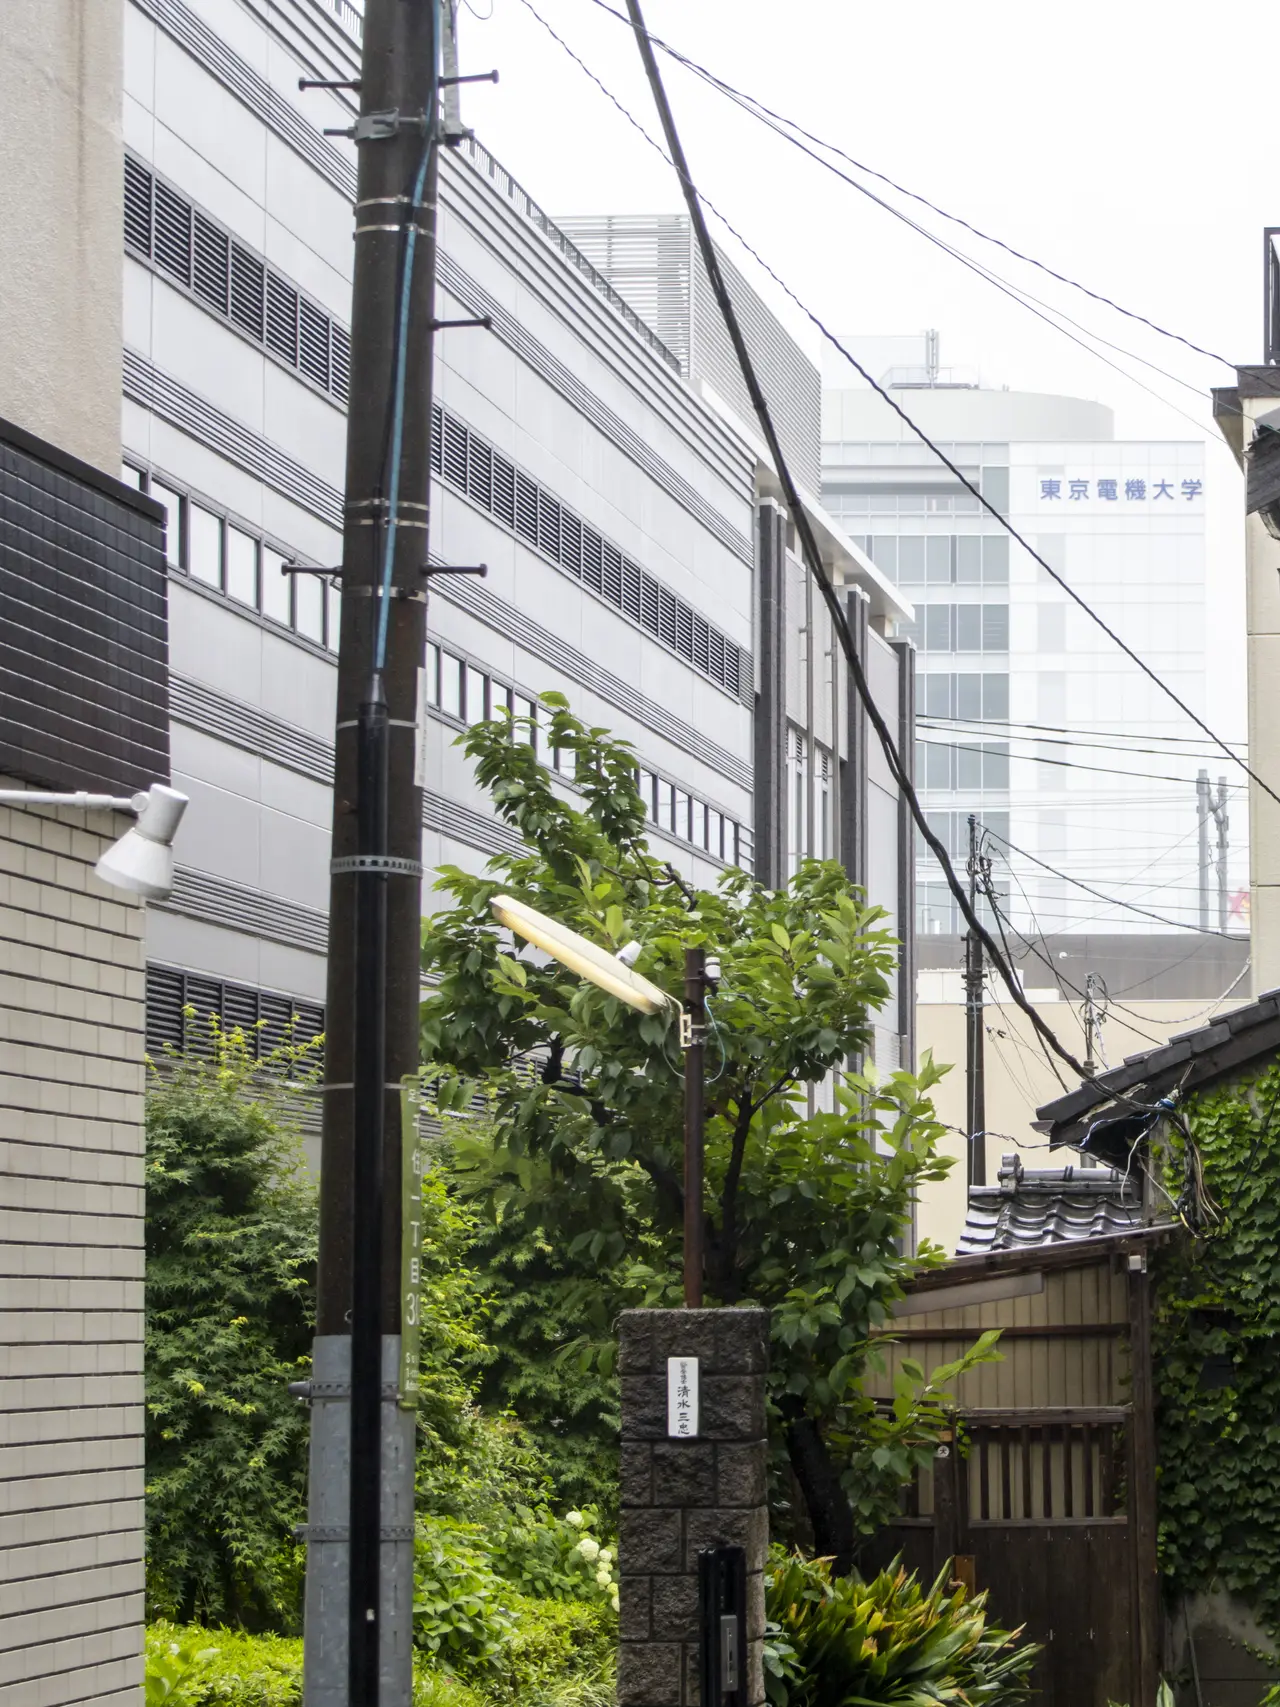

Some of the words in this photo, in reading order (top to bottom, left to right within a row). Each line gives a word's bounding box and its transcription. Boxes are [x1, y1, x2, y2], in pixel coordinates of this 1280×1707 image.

[1040, 479, 1203, 501] 東京電機大学
